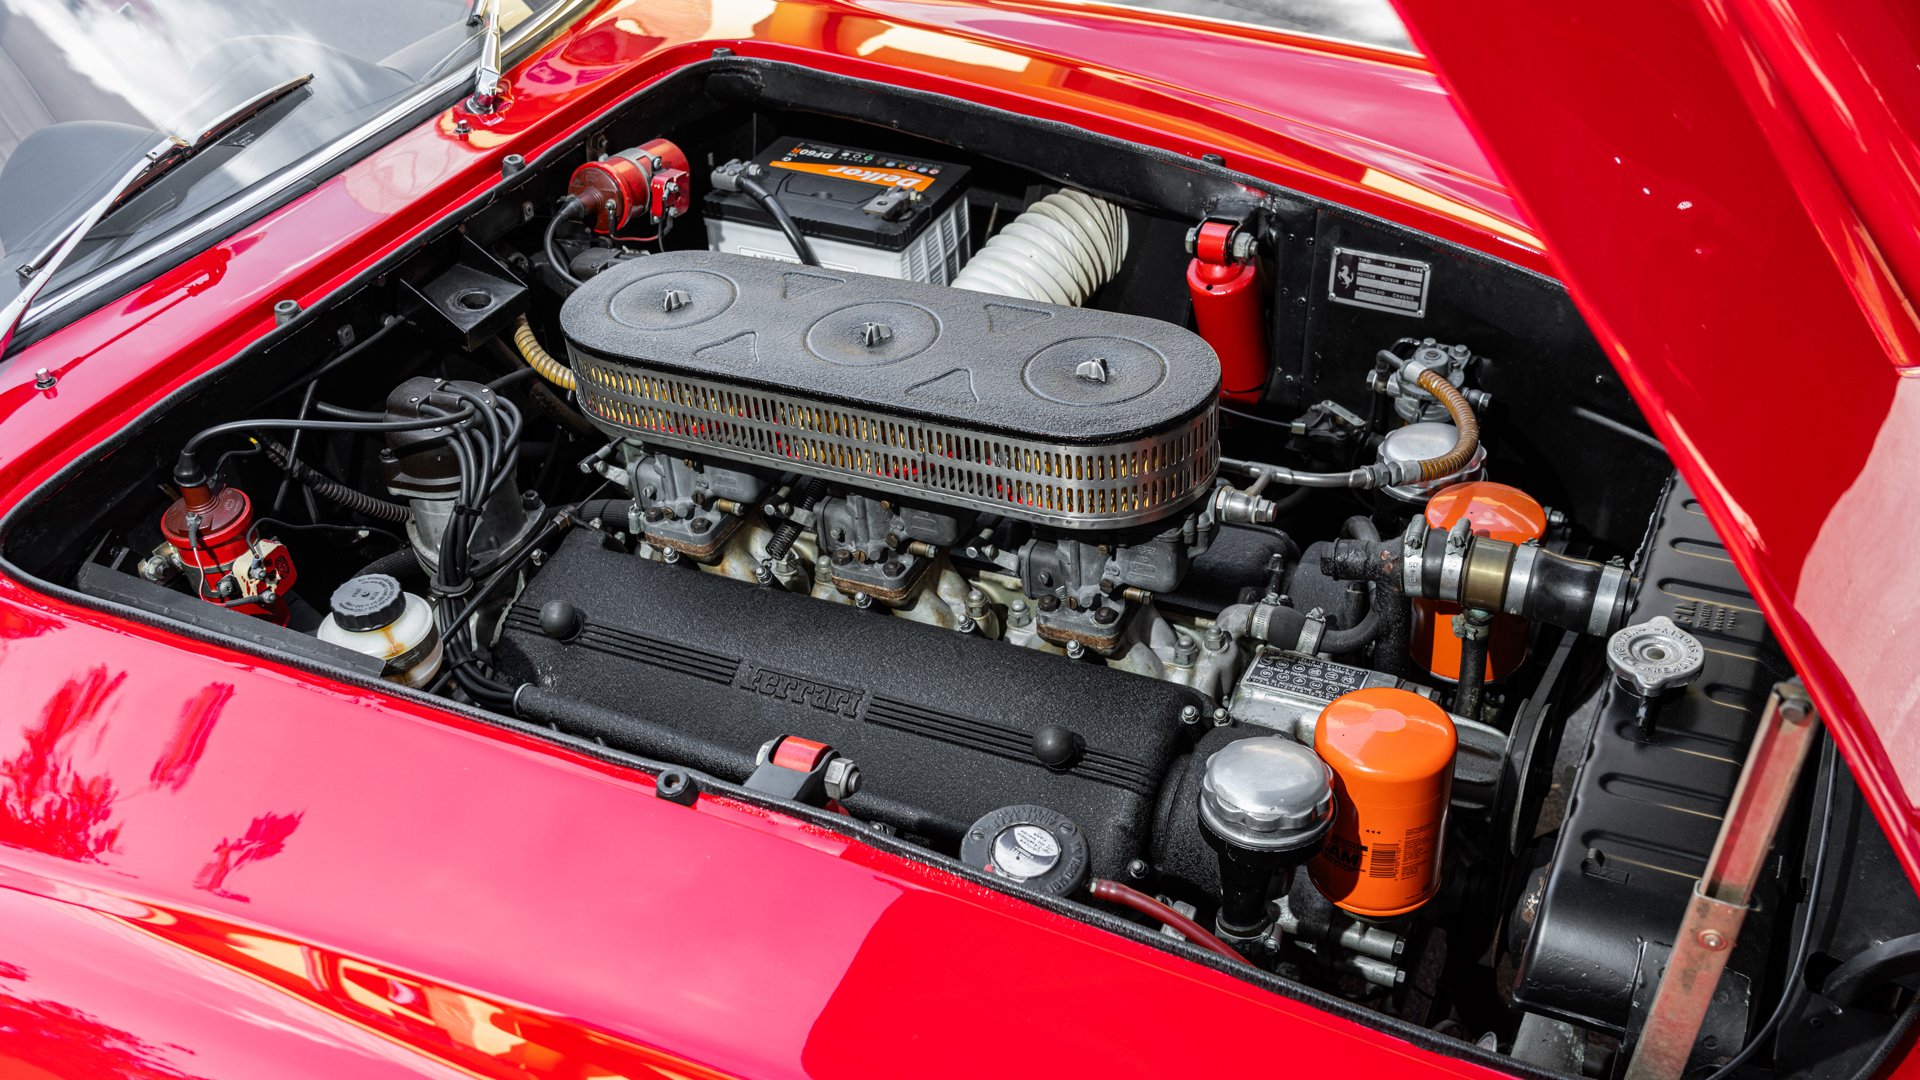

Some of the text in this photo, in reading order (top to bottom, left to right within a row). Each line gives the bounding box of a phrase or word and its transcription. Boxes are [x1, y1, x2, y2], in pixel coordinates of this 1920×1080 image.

[828, 165, 922, 188] Delkor
[1392, 293, 1414, 301] CHASSIS
[740, 667, 866, 718] Ferrari
